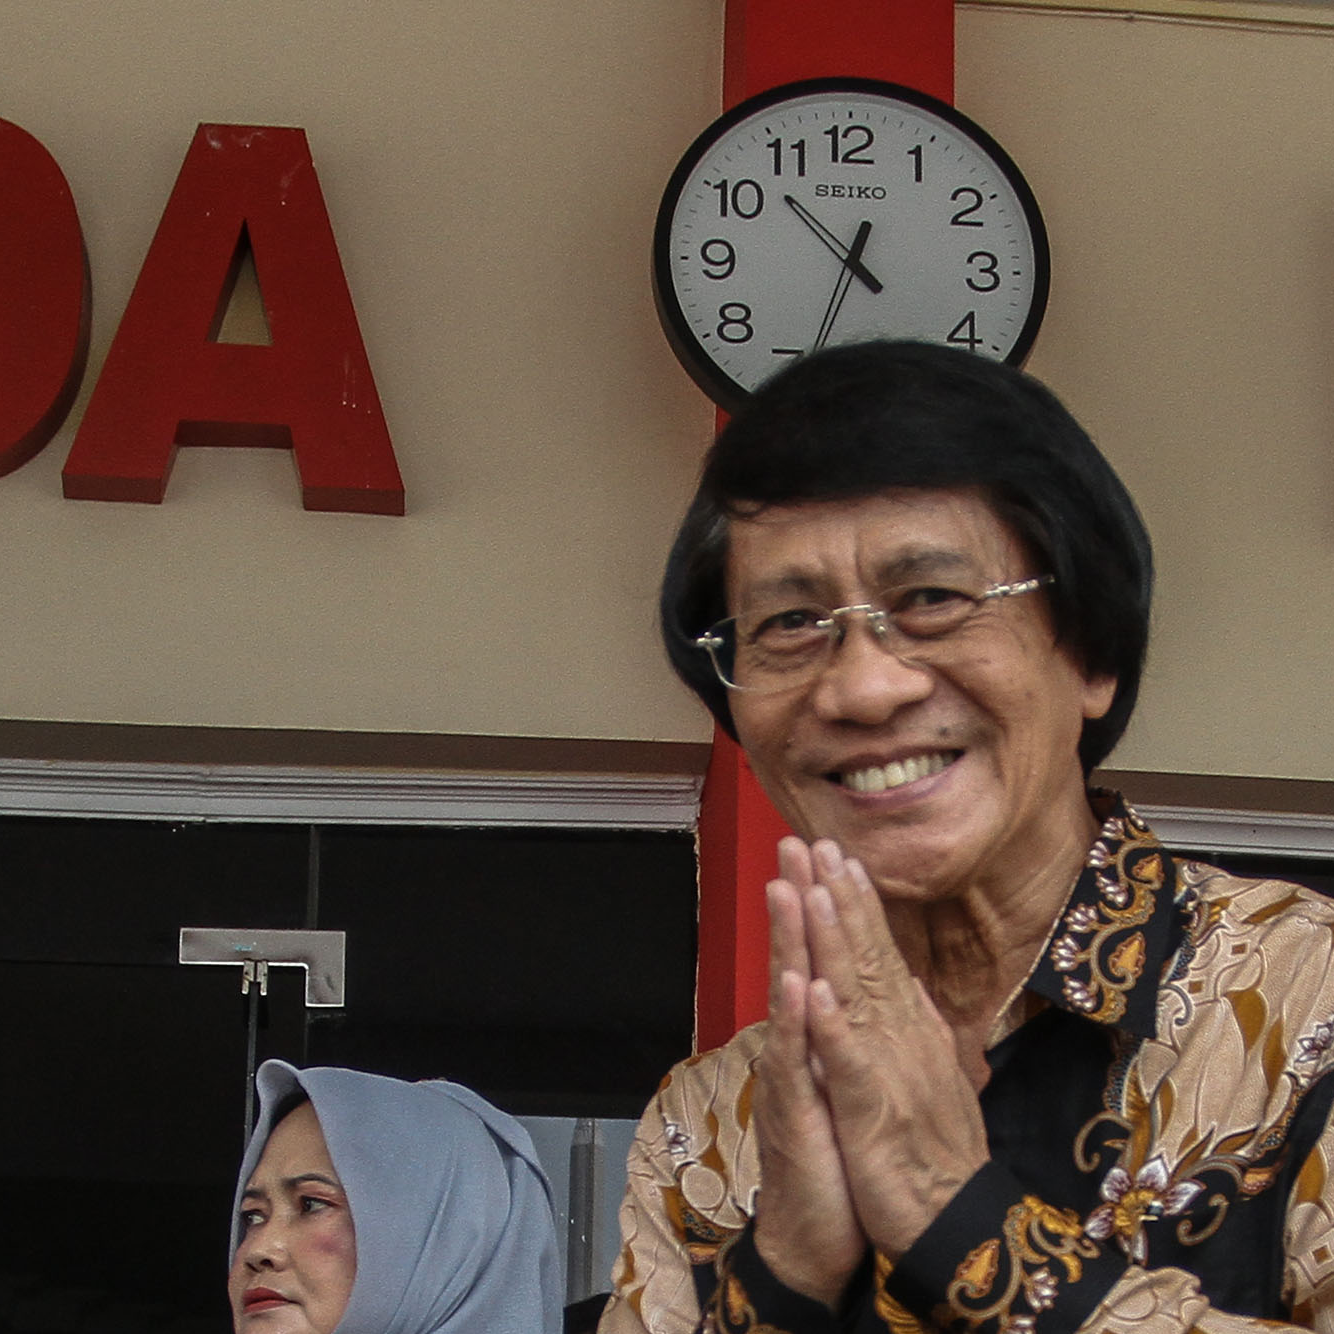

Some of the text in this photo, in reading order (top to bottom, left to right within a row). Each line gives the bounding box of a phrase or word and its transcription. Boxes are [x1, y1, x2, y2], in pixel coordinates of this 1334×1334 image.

[767, 138, 806, 176] 11
[824, 125, 874, 164] 12
[907, 145, 923, 183] 1
[713, 179, 764, 219] 10
[815, 185, 887, 200] SEIKO
[950, 187, 984, 227] 2
[701, 239, 736, 280] 9
[965, 251, 1000, 292] 3
[717, 303, 754, 343] 8
[946, 311, 983, 352] 4
